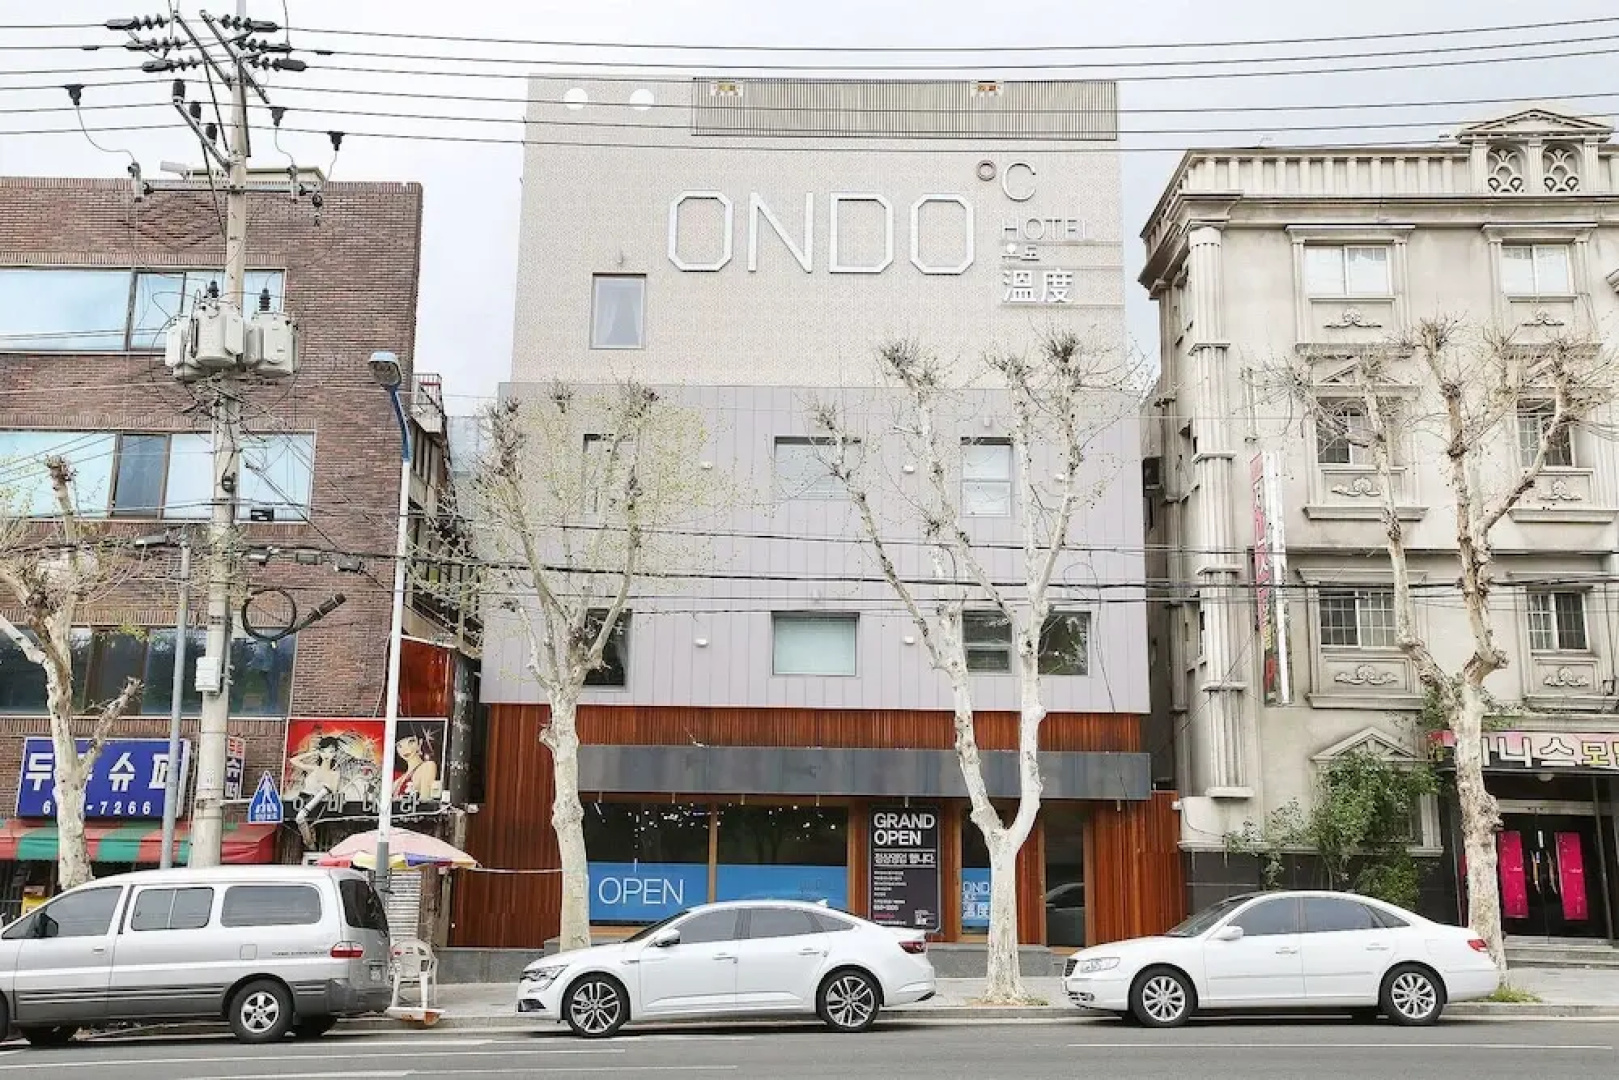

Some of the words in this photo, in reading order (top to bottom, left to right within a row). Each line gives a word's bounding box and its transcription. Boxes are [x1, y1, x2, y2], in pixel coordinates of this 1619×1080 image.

[668, 191, 974, 275] ONDO
[1001, 216, 1087, 240] HOTEL
[42, 801, 151, 816] 6-7266
[873, 812, 936, 829] GRAND
[873, 829, 922, 846] OPEN
[598, 877, 684, 905] OPEN
